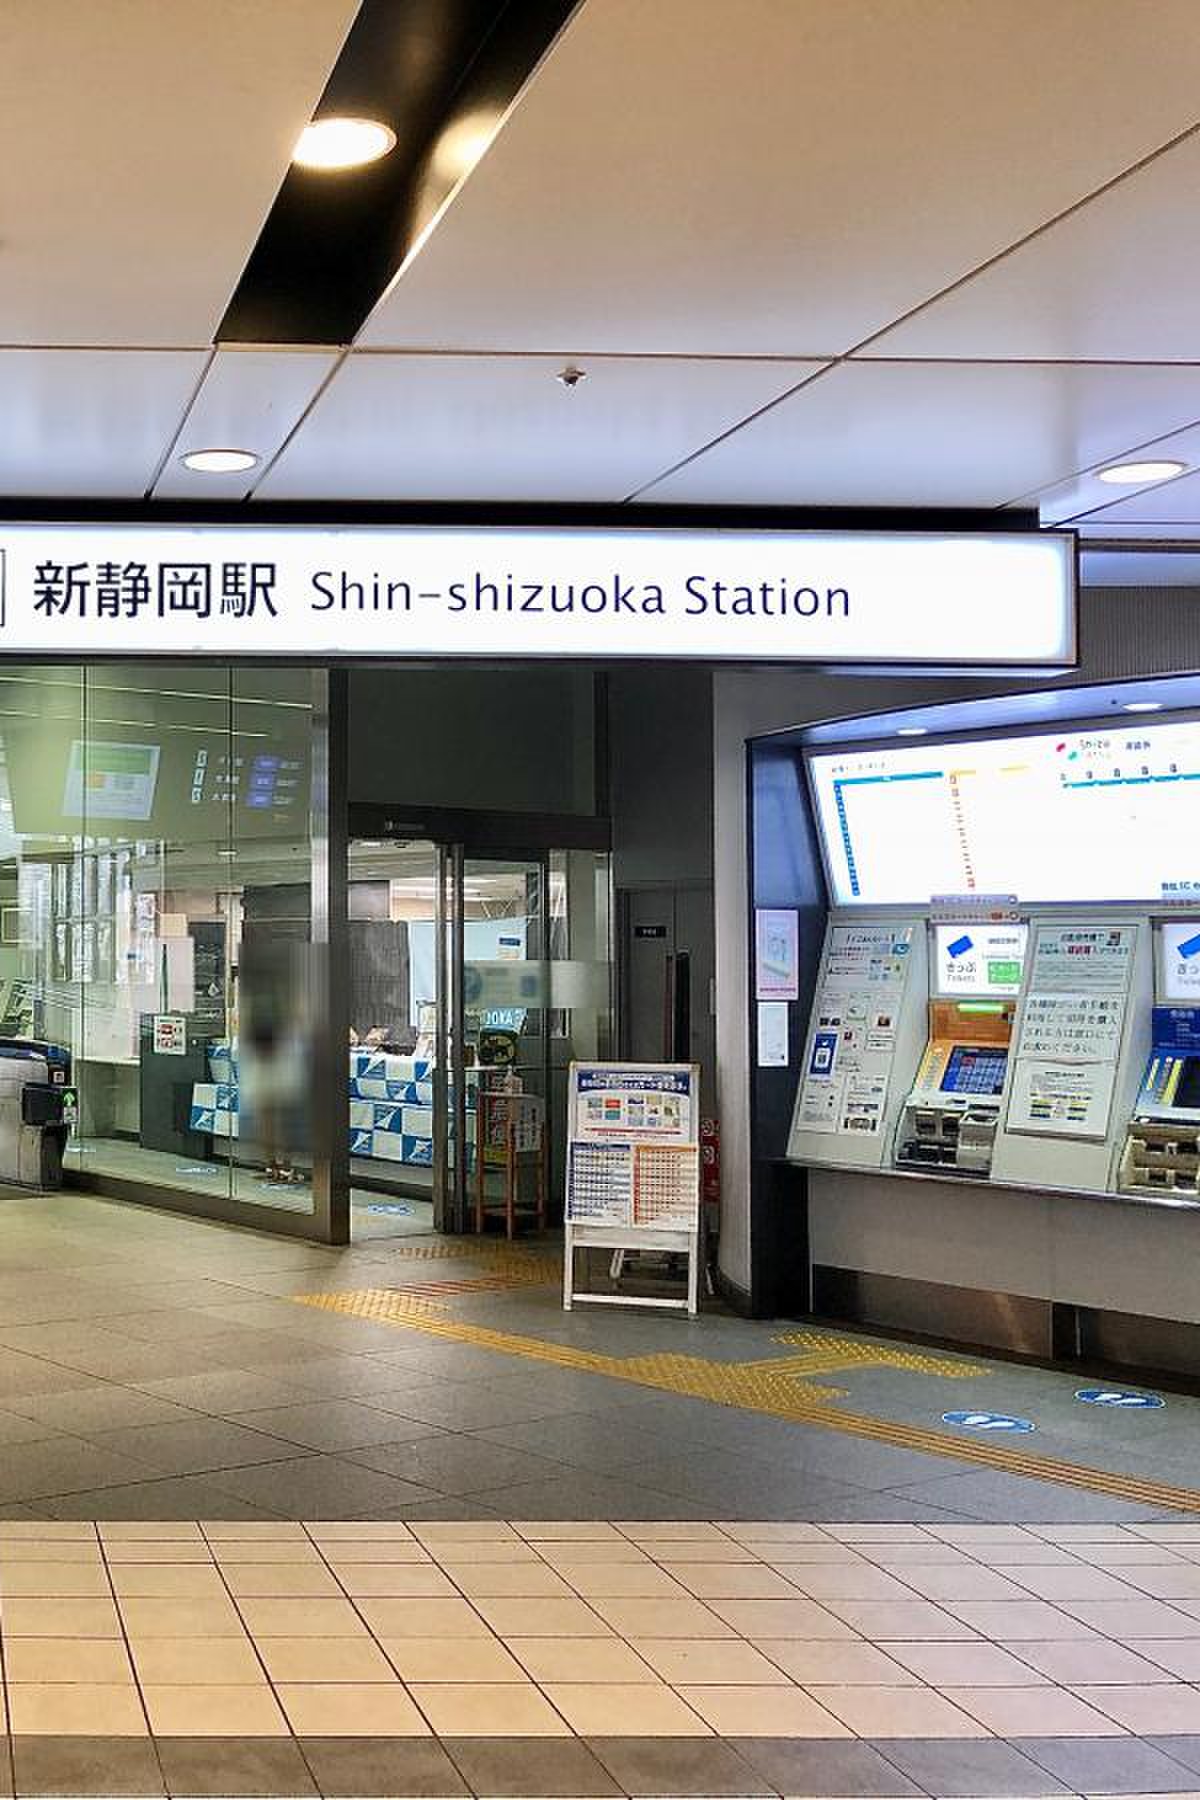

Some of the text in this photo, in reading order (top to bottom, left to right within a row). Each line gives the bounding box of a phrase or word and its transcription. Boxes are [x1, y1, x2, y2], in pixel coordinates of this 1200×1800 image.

[33, 560, 278, 619] 新静岡駅
[311, 571, 849, 617] Shin-shizuoka Station
